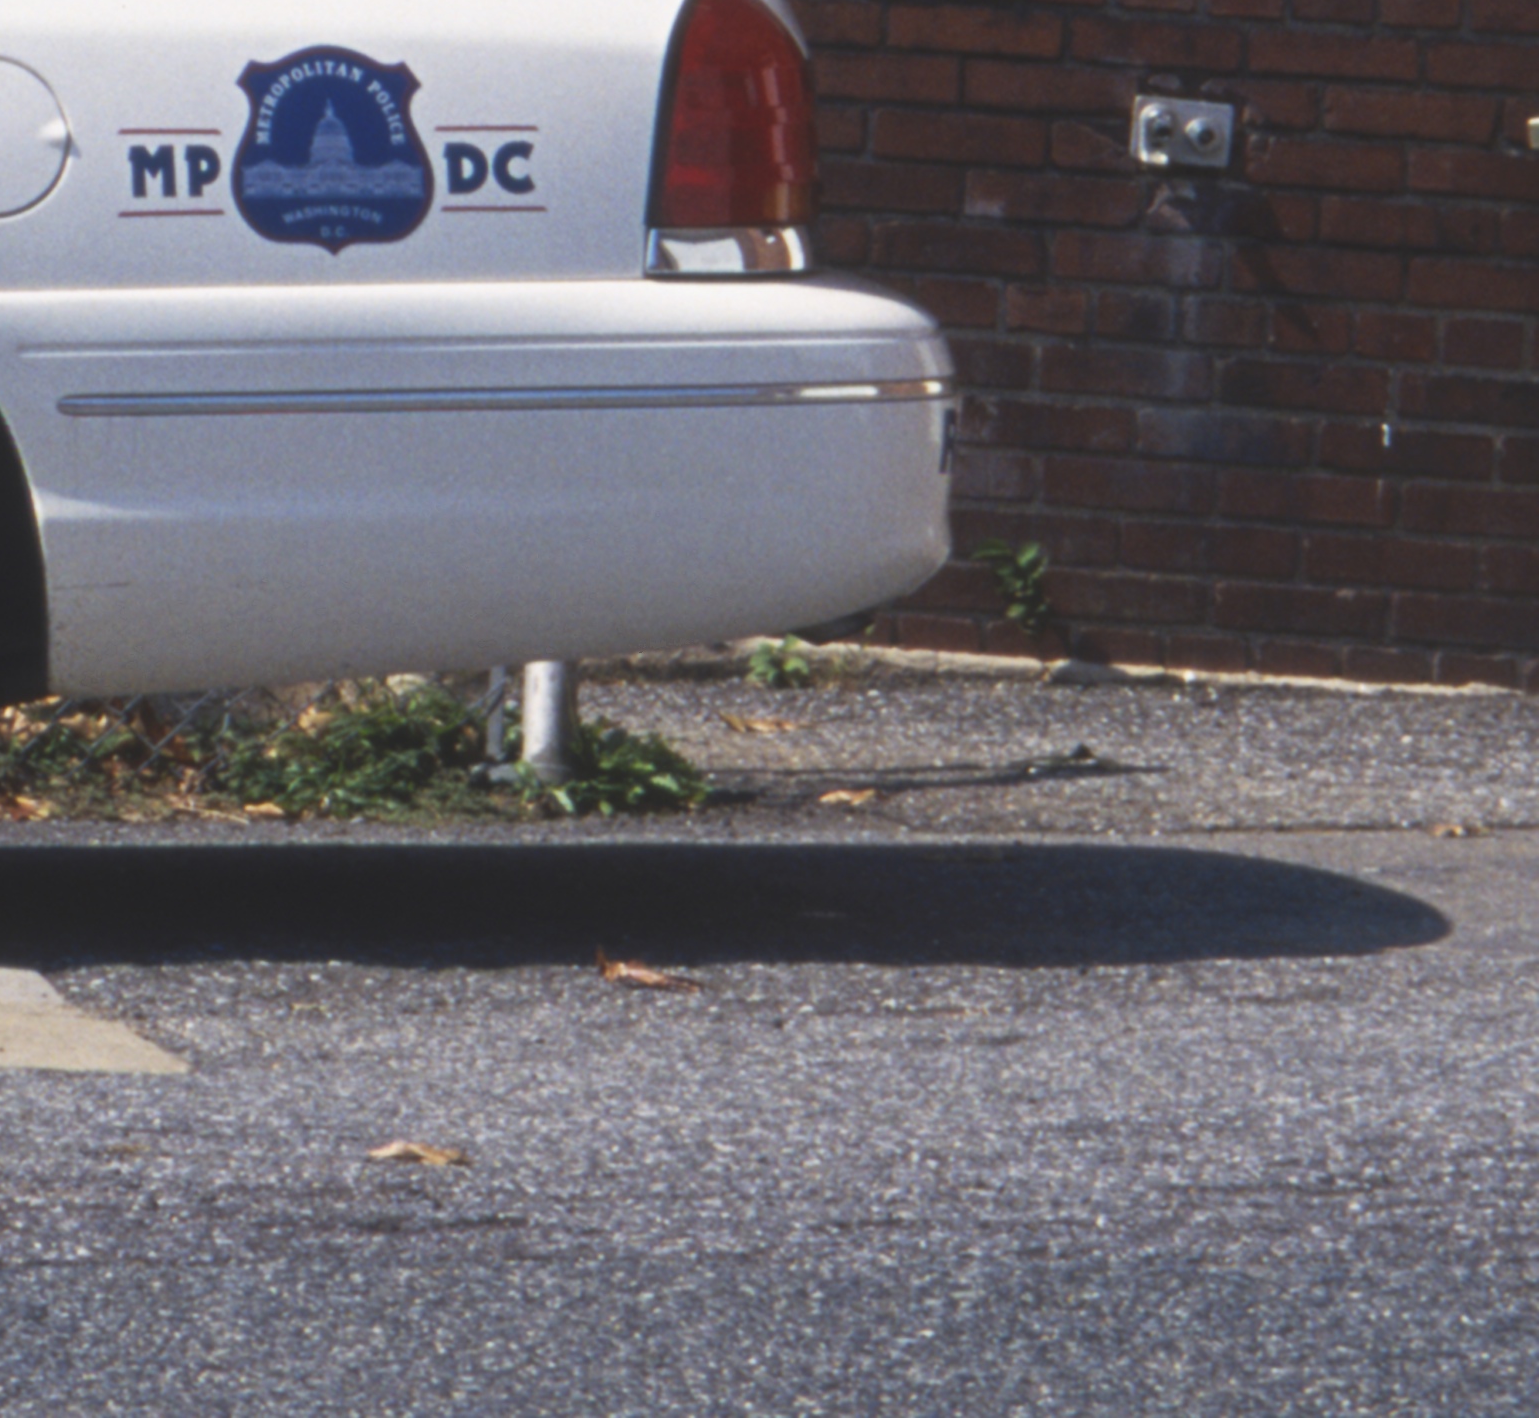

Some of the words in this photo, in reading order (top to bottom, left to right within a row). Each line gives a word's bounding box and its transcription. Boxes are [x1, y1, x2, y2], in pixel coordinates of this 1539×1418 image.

[255, 60, 365, 146] METROPOLITAN
[366, 78, 407, 146] POLICE
[127, 142, 222, 199] MP
[442, 139, 536, 196] DC
[281, 204, 384, 225] WASHINGTON
